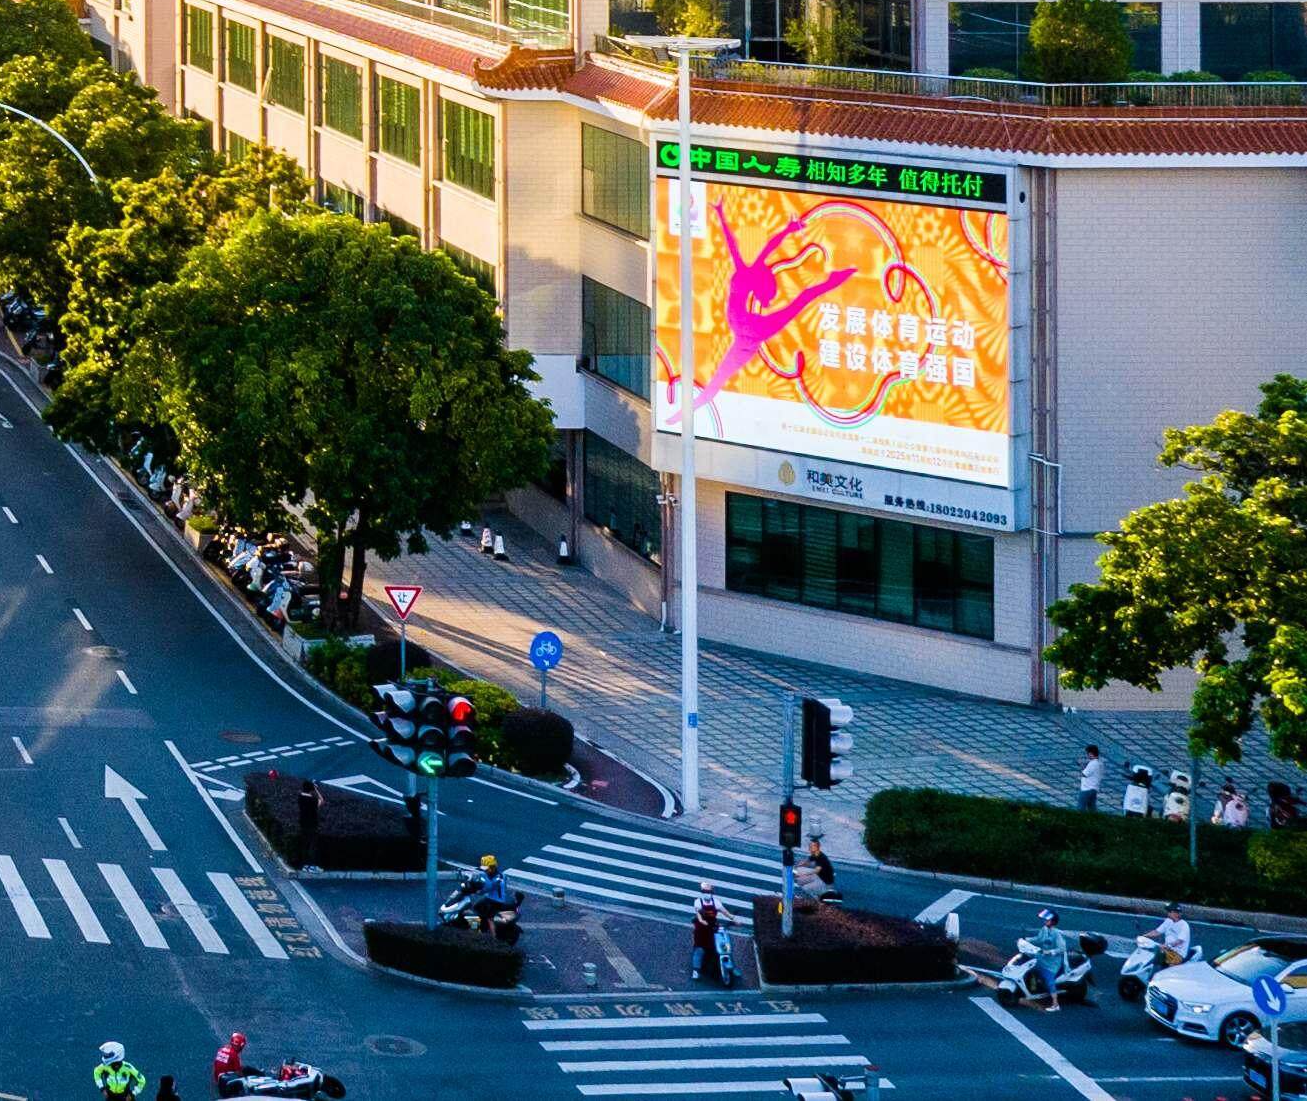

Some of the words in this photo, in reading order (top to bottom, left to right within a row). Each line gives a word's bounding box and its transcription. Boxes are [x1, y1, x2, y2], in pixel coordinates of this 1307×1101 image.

[690, 149, 802, 178] 中国人寿
[806, 158, 889, 188] 相知多年
[899, 168, 983, 198] 值得托付
[818, 303, 975, 350] 发展体育运动
[818, 339, 975, 388] 建设体育强国
[806, 469, 864, 492] 和美文化
[884, 494, 1008, 526] 服务热线:18022042093
